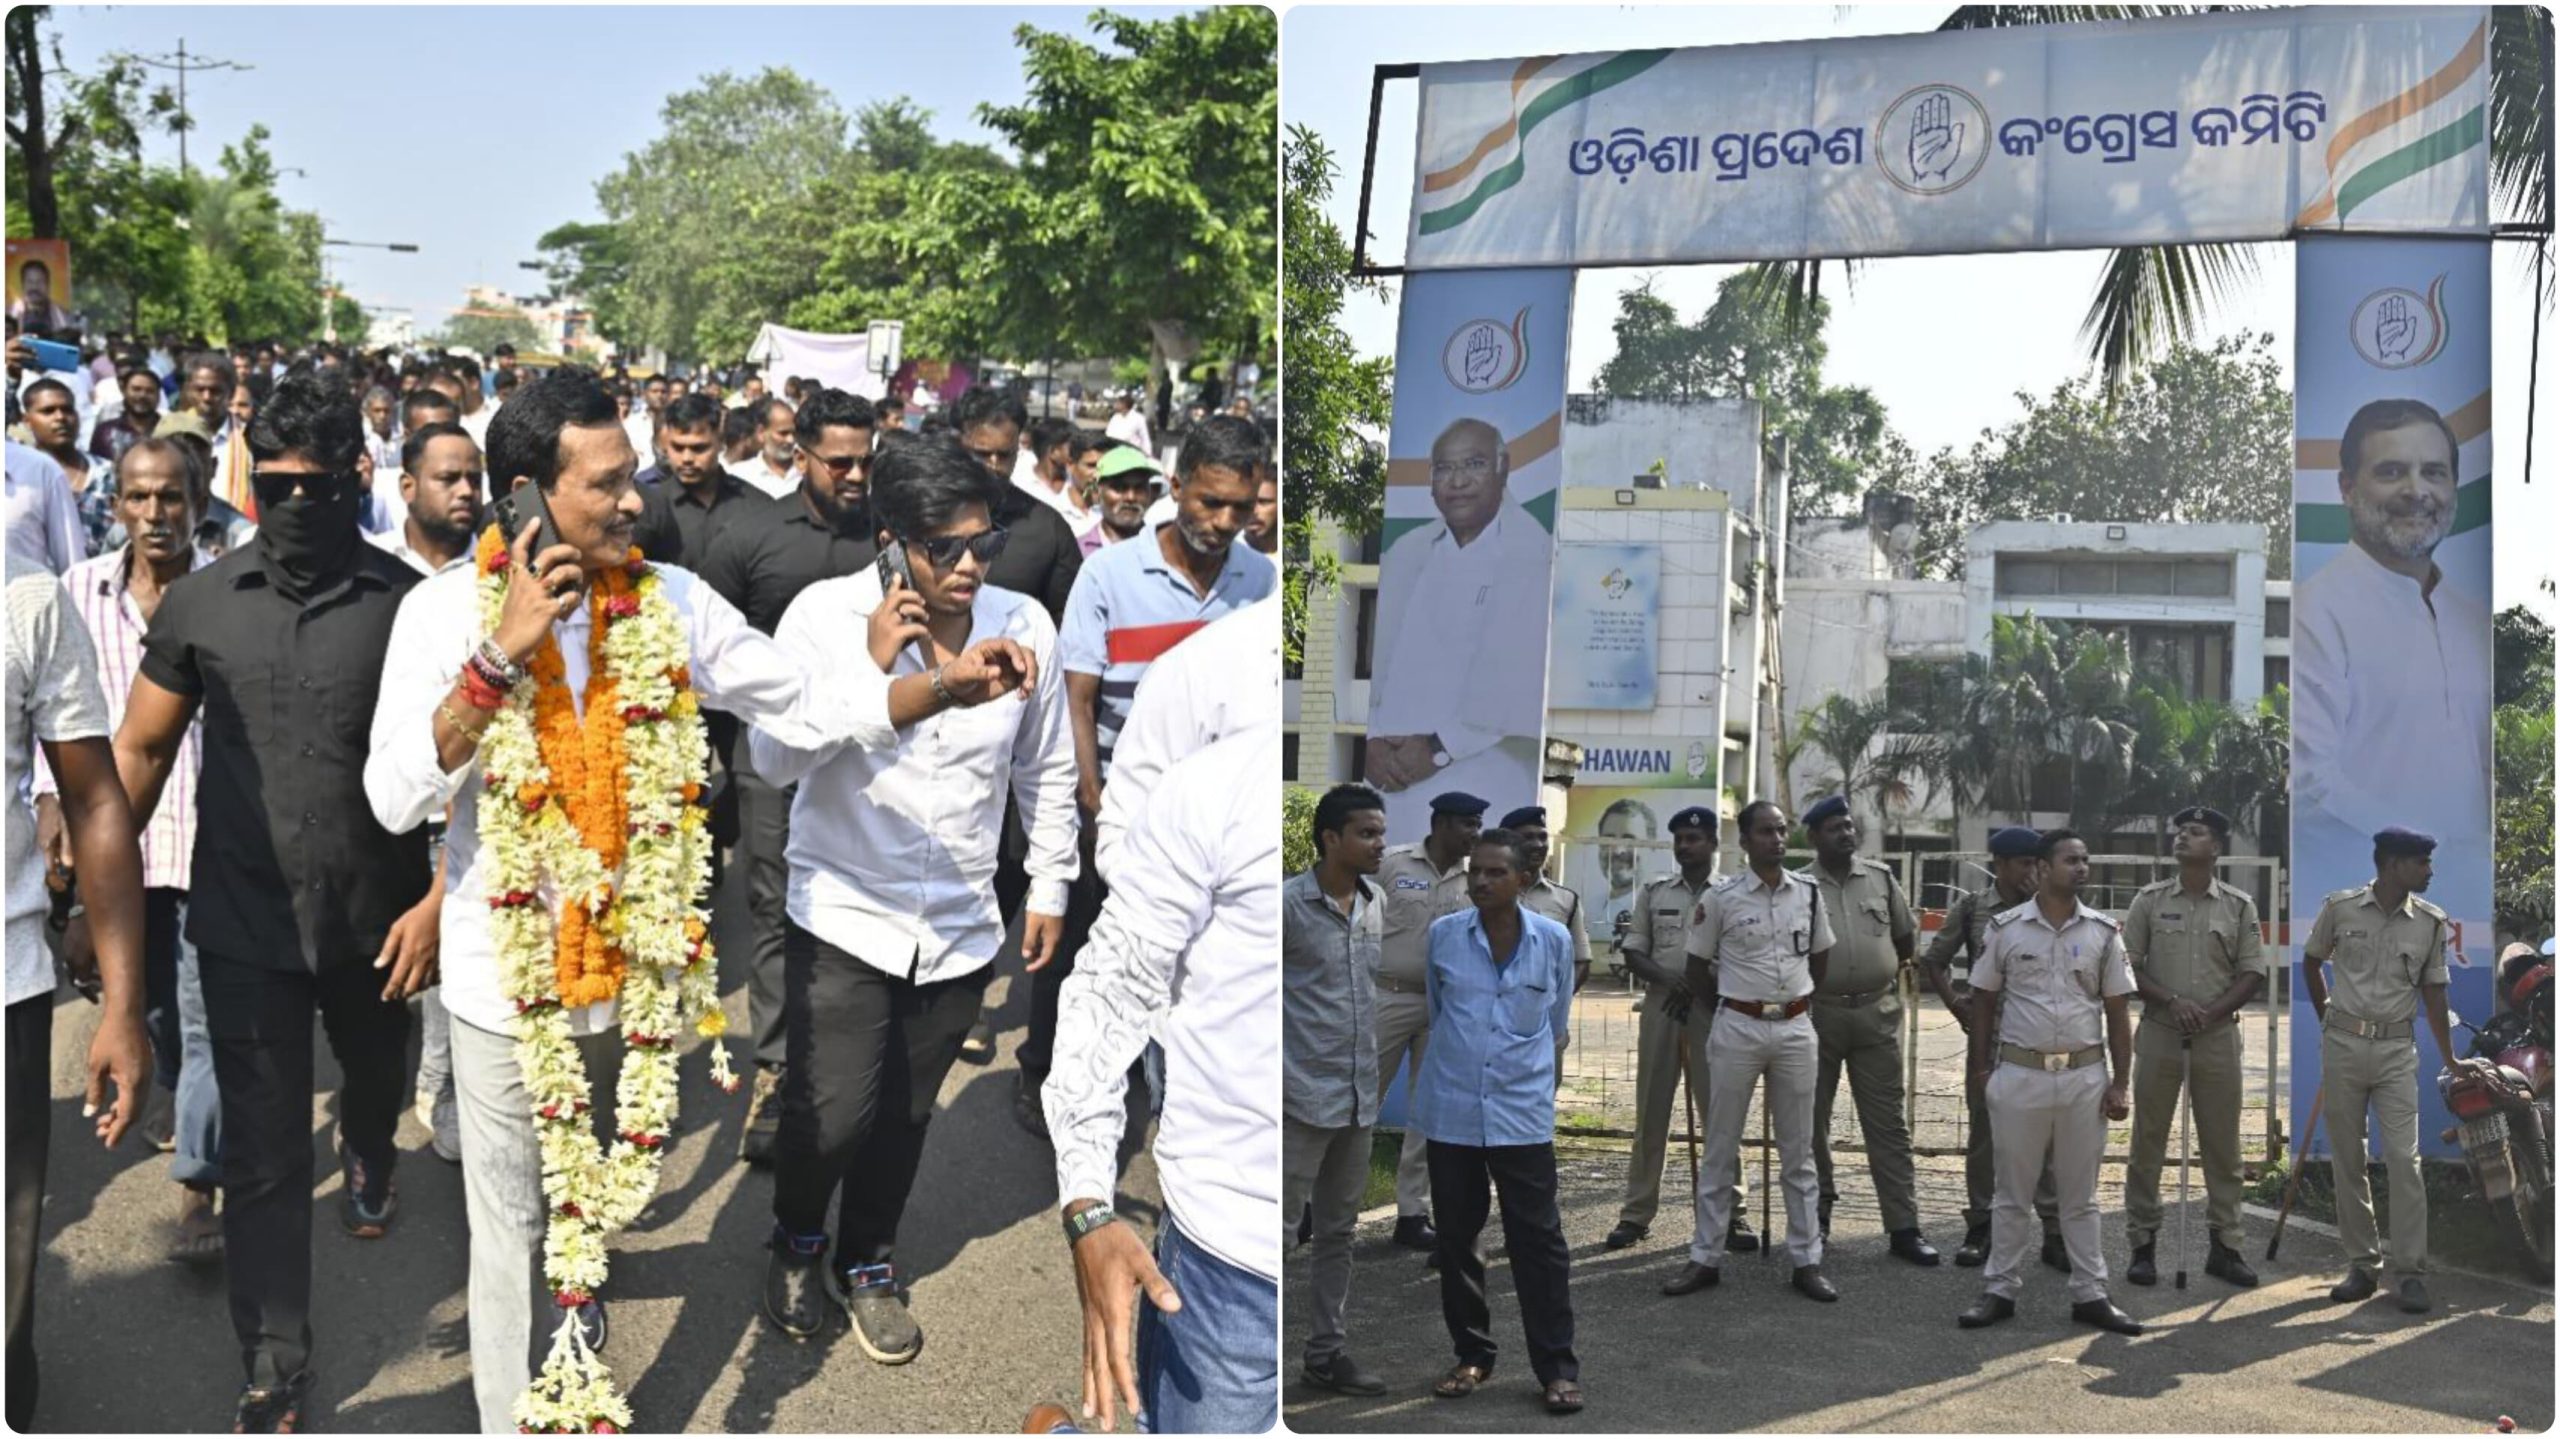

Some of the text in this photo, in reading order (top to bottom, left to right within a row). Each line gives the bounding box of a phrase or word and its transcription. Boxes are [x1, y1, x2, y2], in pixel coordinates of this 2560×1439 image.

[1569, 90, 2327, 184] ଓଡ଼ିଶା ପ୍ରଦେଶ କଂଗ୍ରେସ କମିଟି
[1576, 748, 1671, 773] HAWAN
